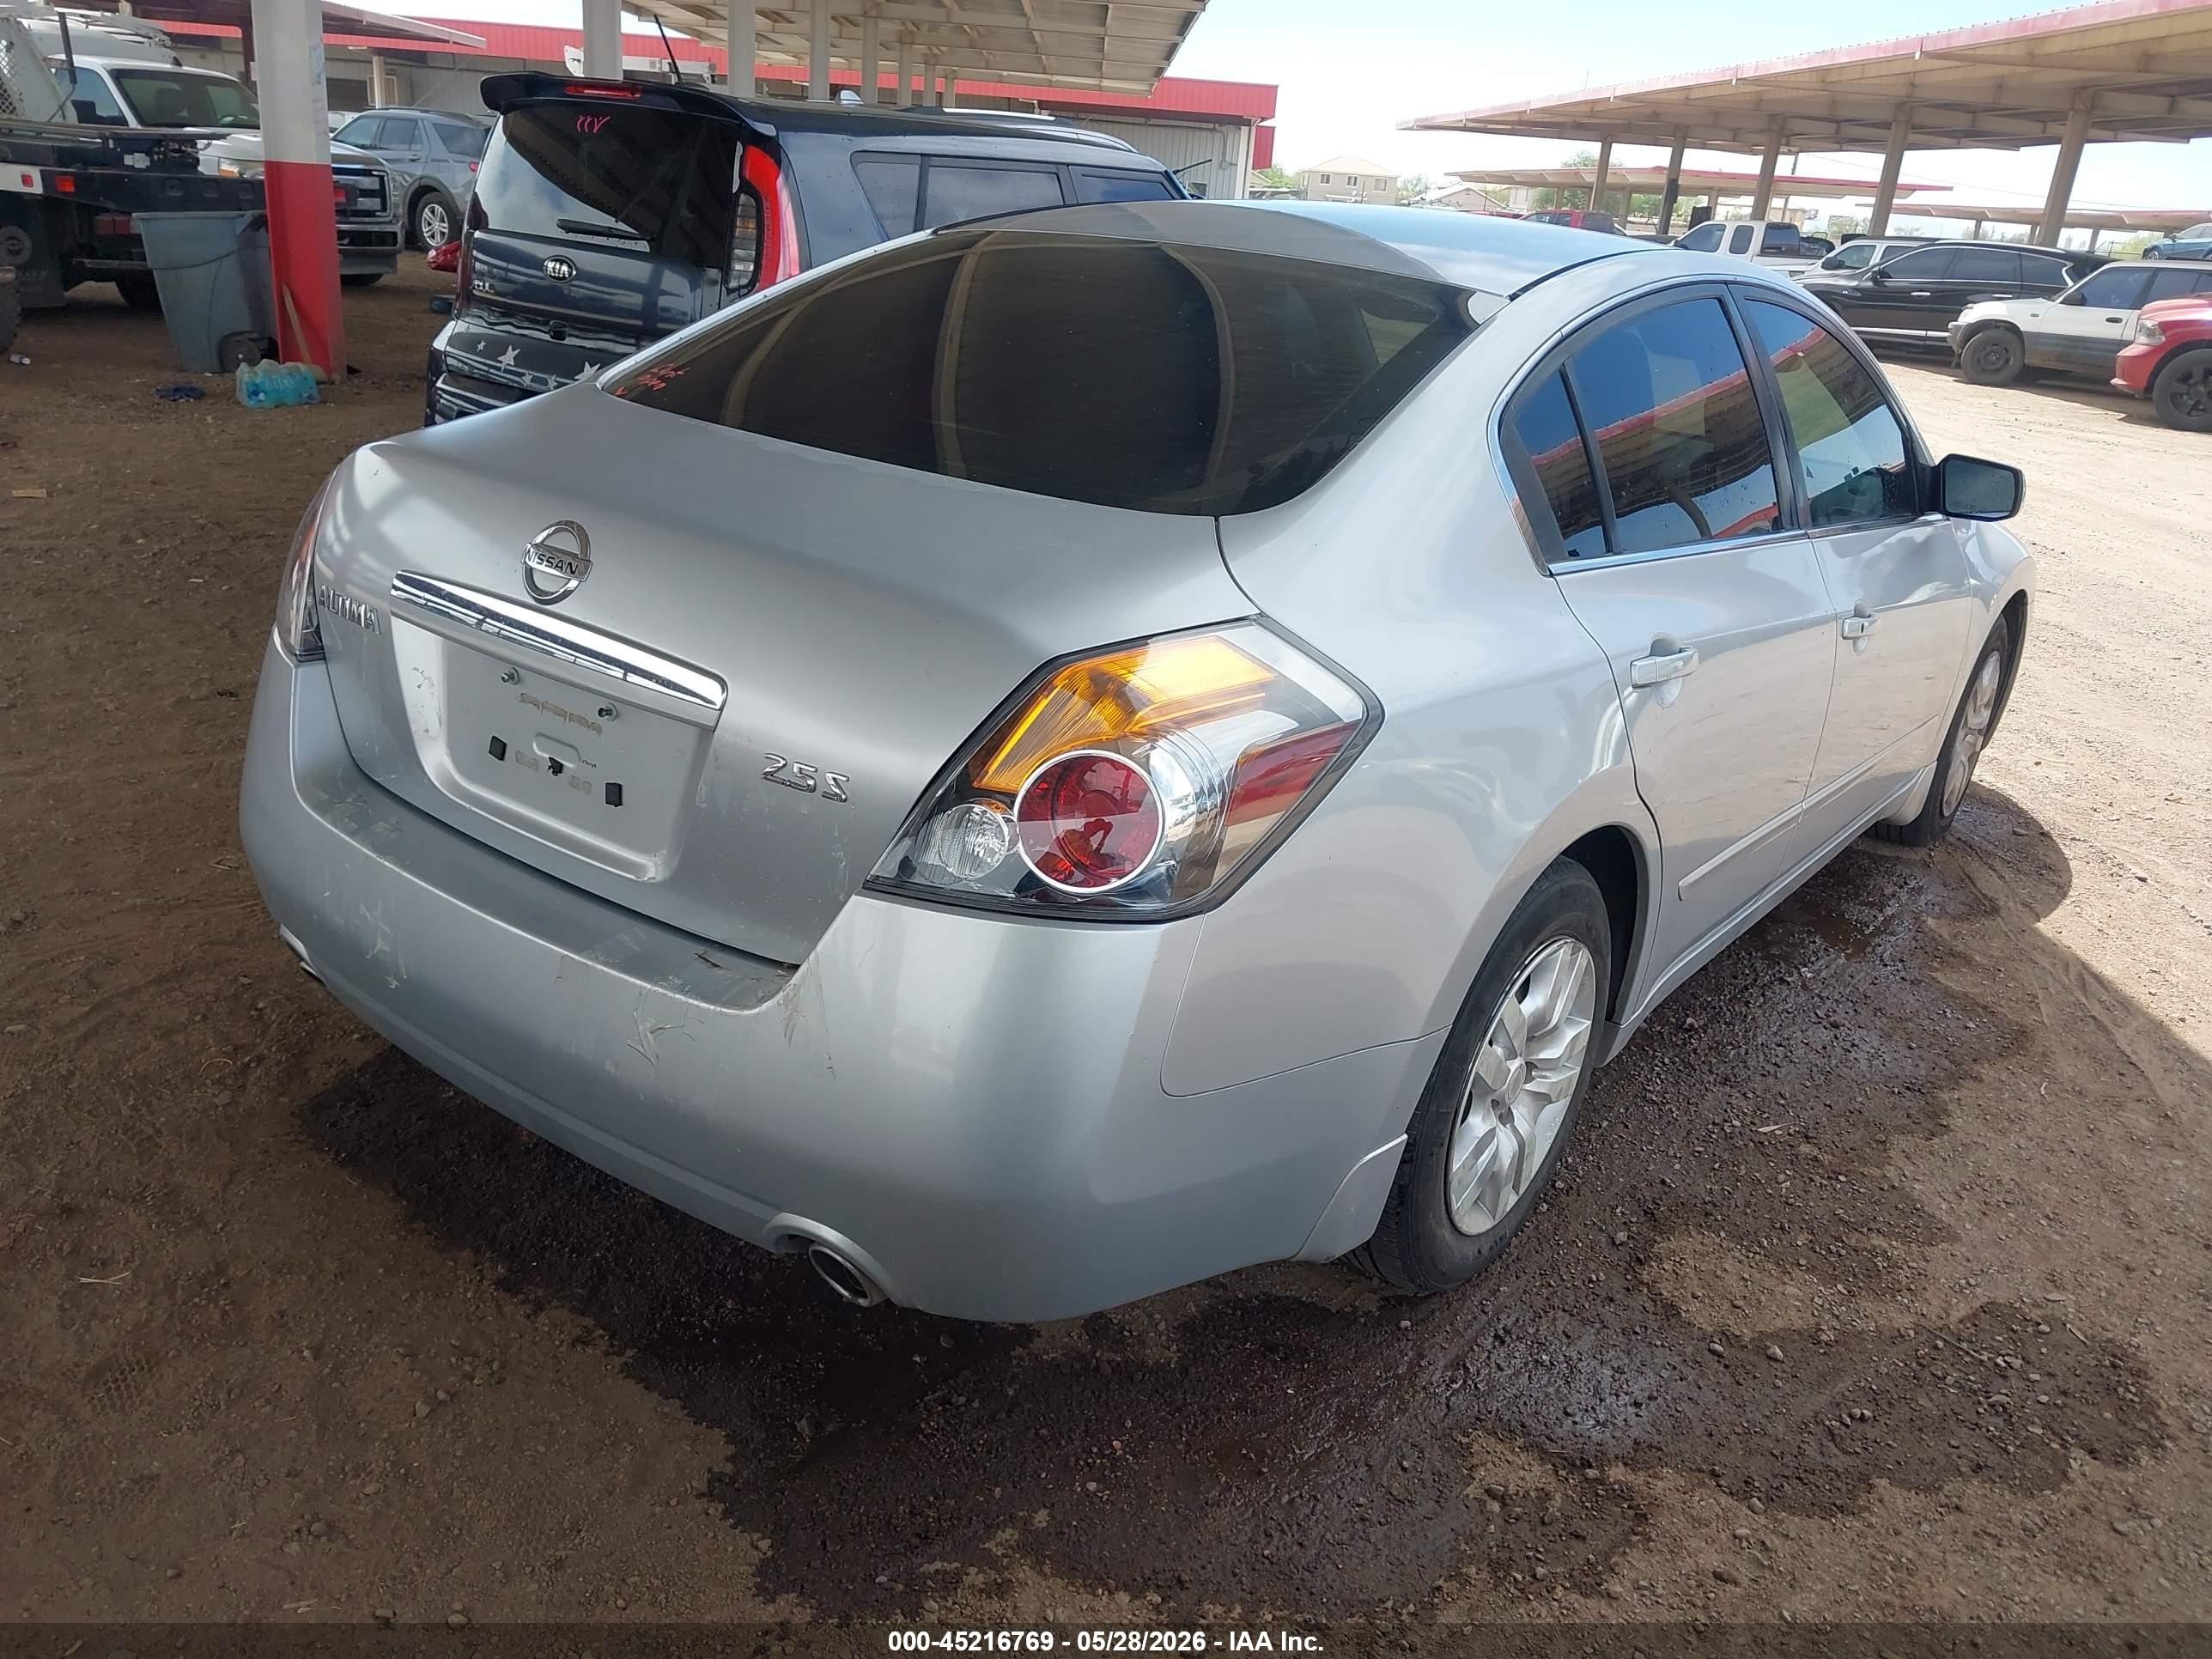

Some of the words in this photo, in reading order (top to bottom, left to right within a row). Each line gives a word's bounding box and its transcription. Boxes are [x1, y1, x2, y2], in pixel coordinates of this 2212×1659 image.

[546, 260, 569, 278] KIA
[526, 547, 580, 575] NISSAN
[319, 585, 380, 635] ALTIMA
[821, 771, 849, 803] S
